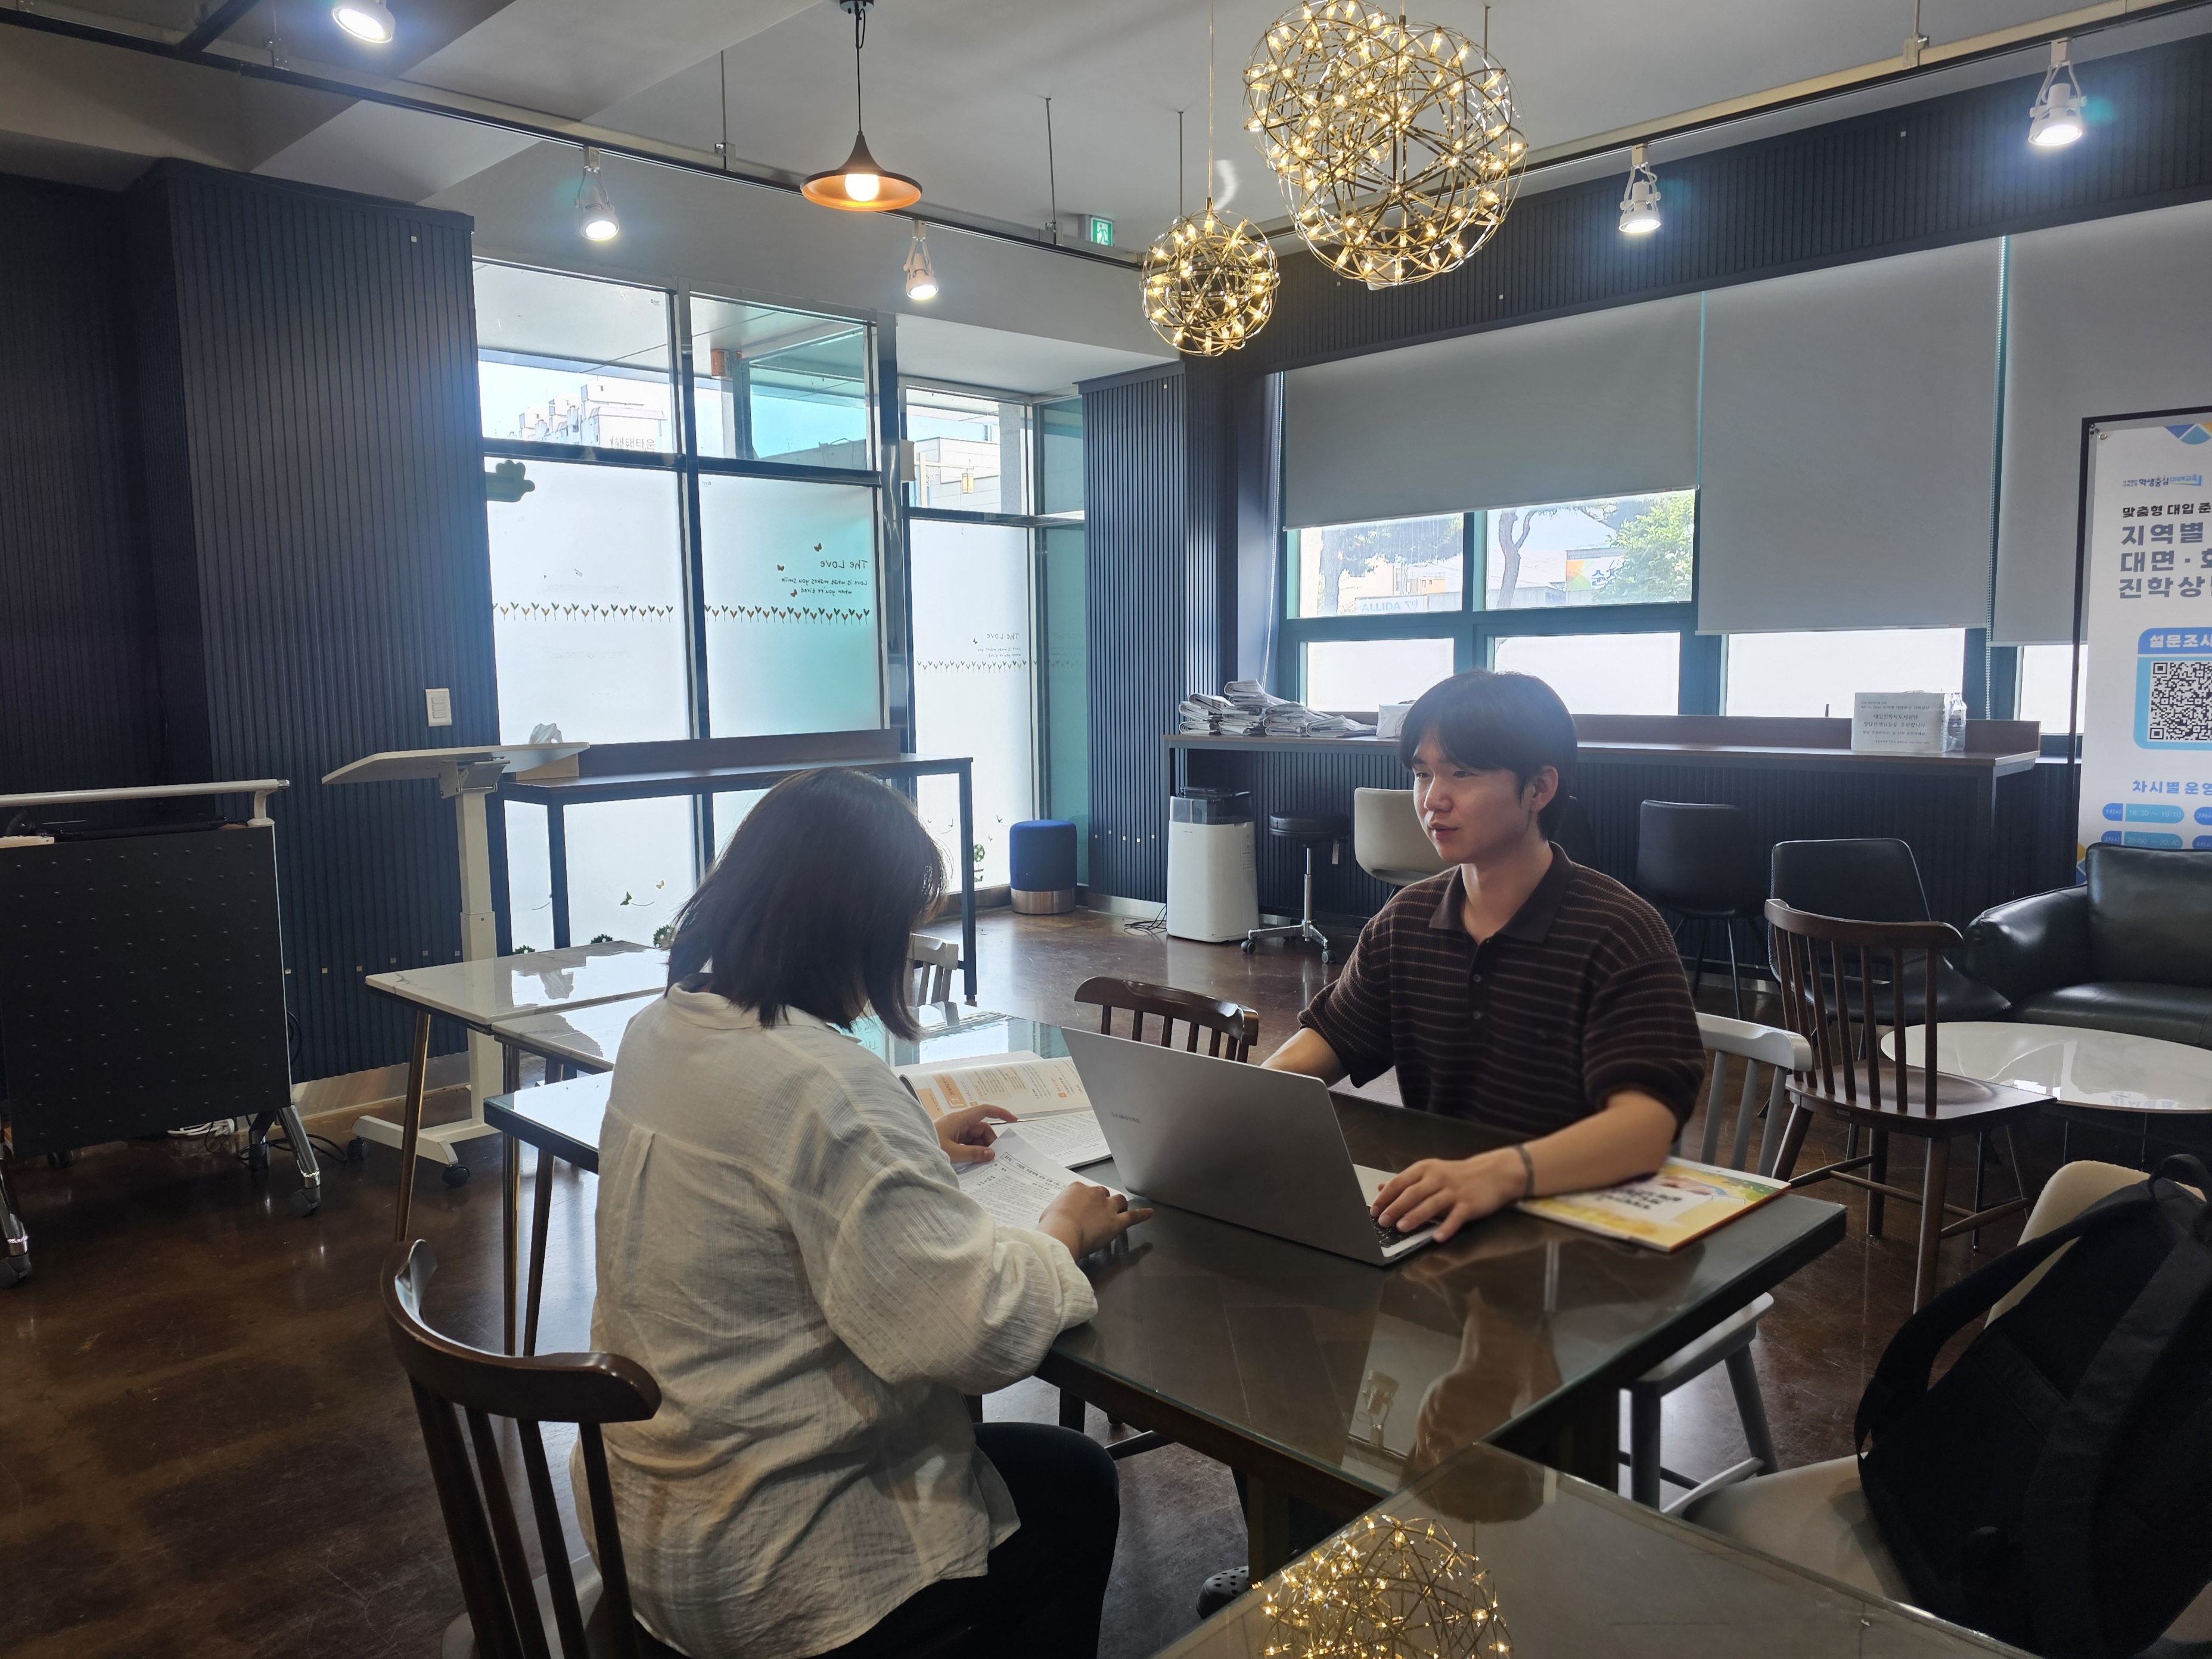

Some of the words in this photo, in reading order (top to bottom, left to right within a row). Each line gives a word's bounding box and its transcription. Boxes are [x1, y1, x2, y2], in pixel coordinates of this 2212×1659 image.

[2122, 505, 2163, 518] 맞춤형
[2167, 503, 2194, 515] 대입
[2121, 521, 2203, 546] 지역별
[2118, 576, 2212, 599] 진학상
[1362, 601, 1400, 612] ALLIDA
[2132, 780, 2179, 794] 차시별
